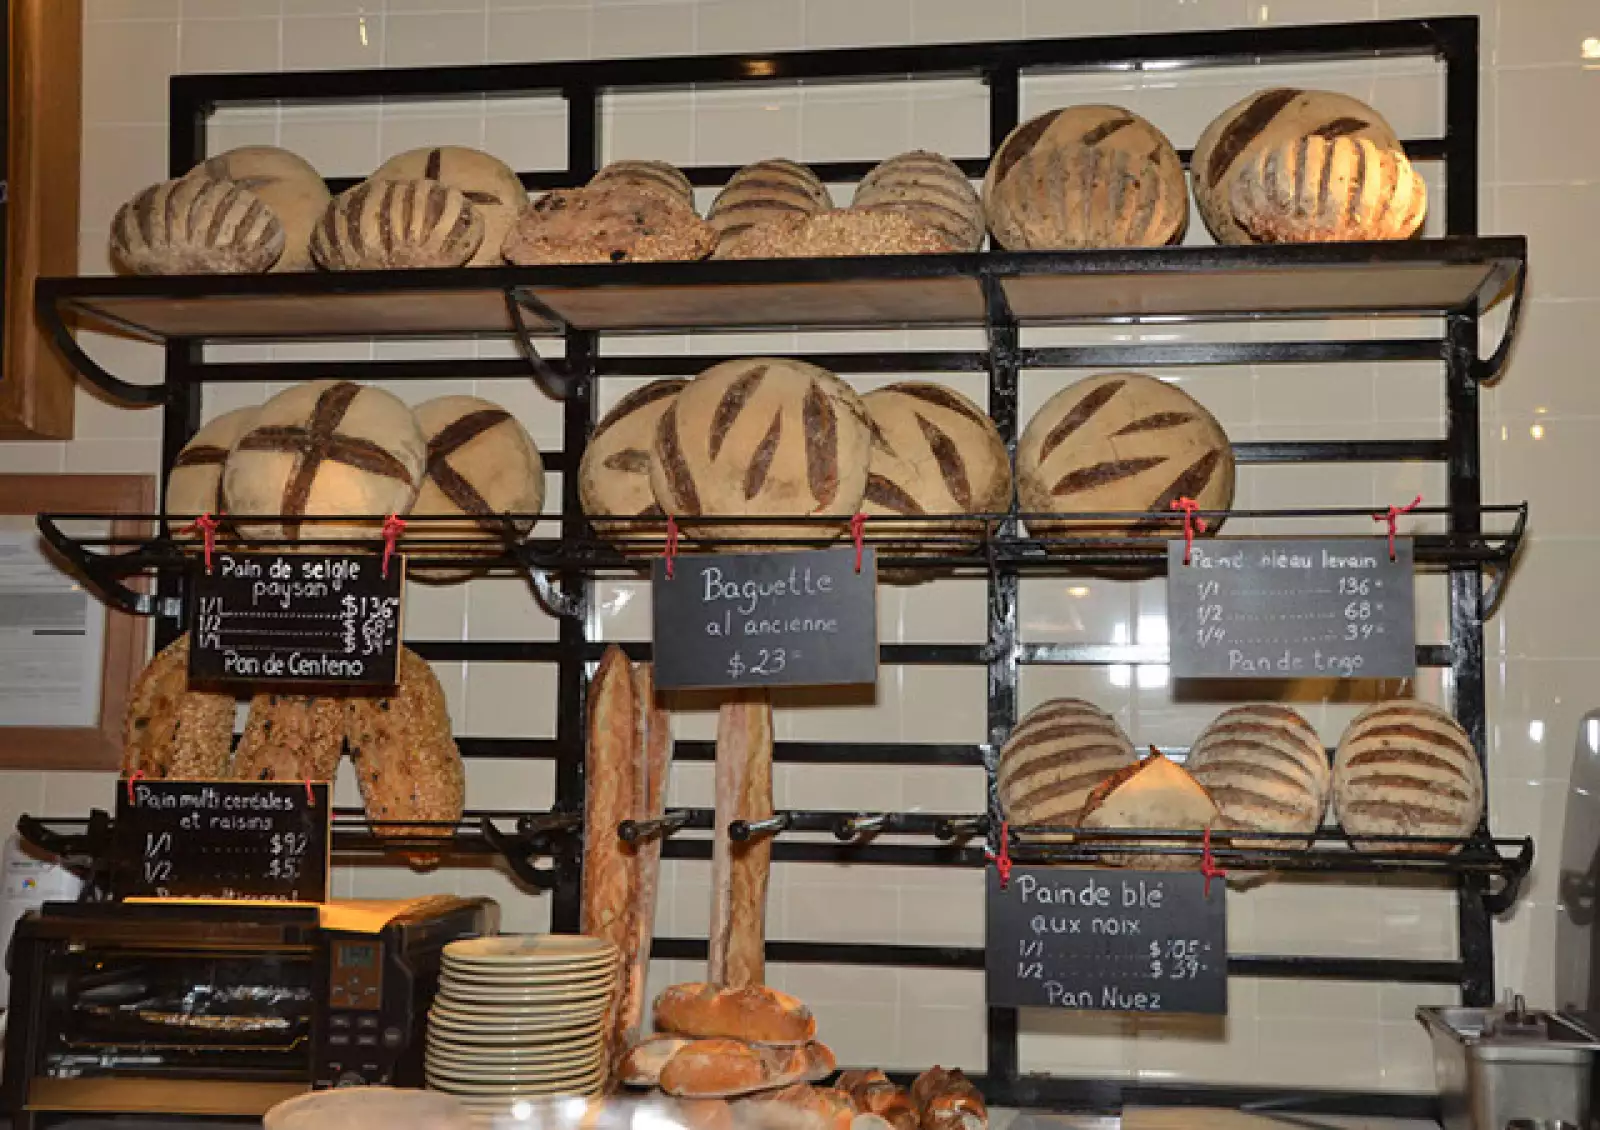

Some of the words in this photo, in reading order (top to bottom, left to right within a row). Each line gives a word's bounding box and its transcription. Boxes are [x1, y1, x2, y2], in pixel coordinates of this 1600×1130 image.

[219, 555, 262, 579] Pain
[269, 557, 292, 579] de
[252, 581, 328, 608] paysan
[701, 566, 835, 615] Baguette
[743, 618, 839, 636] ancienne
[223, 650, 261, 675] Pan
[263, 652, 285, 676] de
[288, 651, 364, 676] Centeno
[1229, 649, 1272, 671] Pan
[1276, 650, 1304, 672] de
[135, 784, 176, 810] Pain
[179, 811, 201, 830] et
[1121, 879, 1164, 909] blé
[1030, 914, 1081, 936] aux
[1091, 916, 1142, 936] noix
[1043, 979, 1094, 1008] Pan
[1101, 984, 1162, 1010] Nuez
